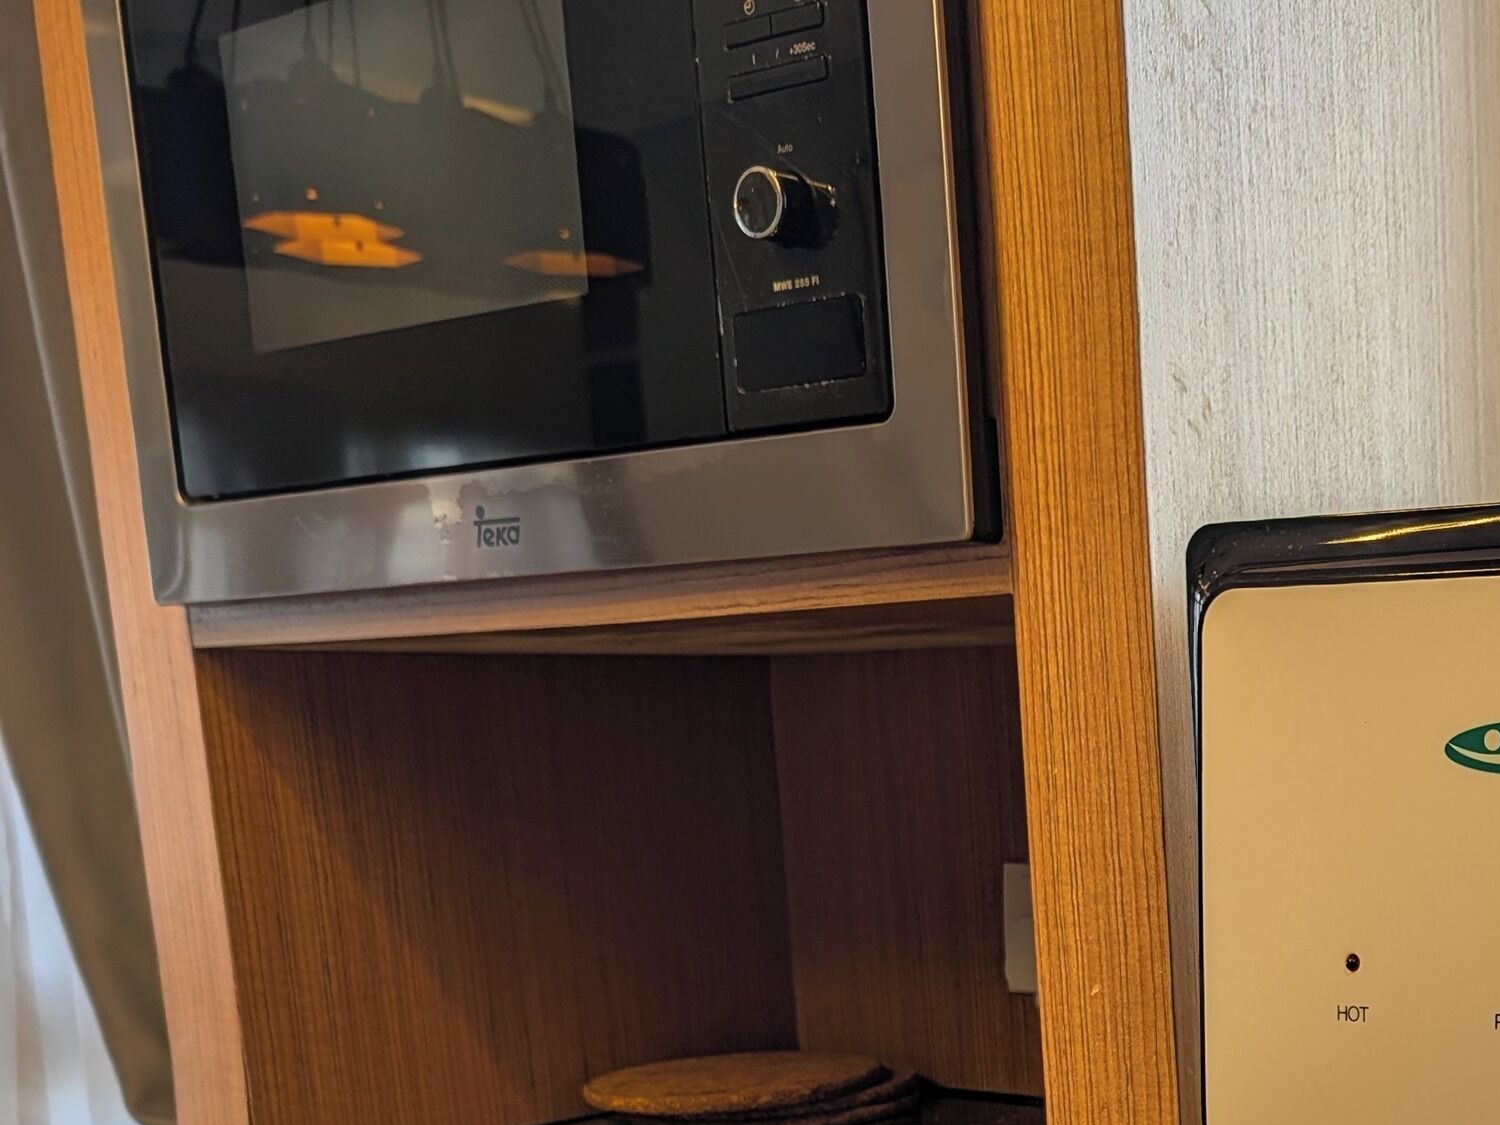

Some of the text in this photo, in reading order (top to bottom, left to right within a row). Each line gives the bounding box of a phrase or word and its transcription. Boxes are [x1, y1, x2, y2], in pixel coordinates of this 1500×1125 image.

[773, 279, 792, 292] MWE
[473, 505, 520, 548] Teka
[1336, 1005, 1370, 1024] HOT
